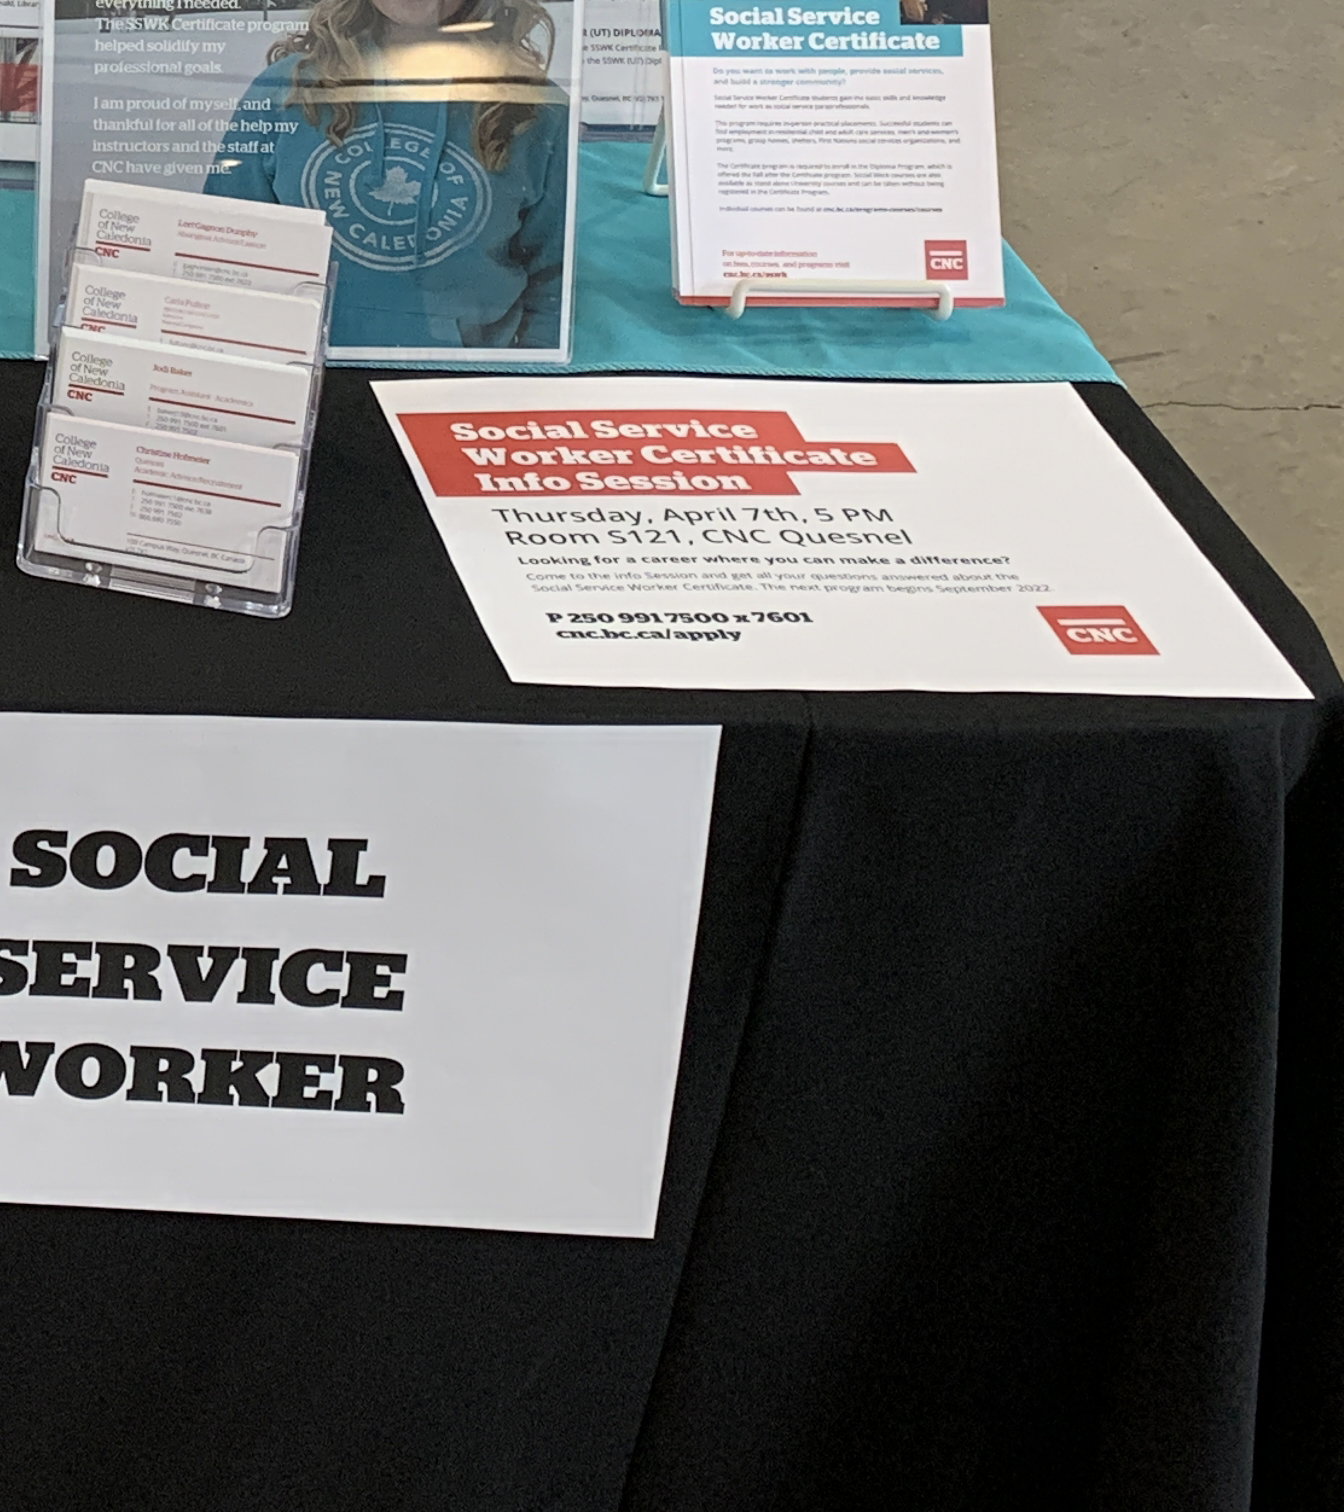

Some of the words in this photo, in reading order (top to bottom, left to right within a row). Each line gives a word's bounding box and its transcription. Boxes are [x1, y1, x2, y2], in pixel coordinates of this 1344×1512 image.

[710, 7, 784, 25] Social
[788, 6, 879, 24] Service
[711, 32, 803, 51] Worker
[808, 31, 939, 51] Certificate
[930, 258, 963, 270] CNC
[450, 421, 589, 441] Social
[592, 420, 758, 439] Service
[462, 446, 633, 466] Worker
[642, 446, 878, 467] Certificate
[476, 472, 572, 492] Info
[580, 471, 752, 491] Session
[492, 507, 654, 526] Thursday,
[662, 507, 735, 525] April
[746, 507, 808, 525] 7th,
[814, 508, 836, 523] 5
[841, 508, 894, 523] PM
[505, 530, 600, 546] Room
[609, 529, 694, 546] S121,
[702, 529, 771, 545] CNC
[780, 528, 912, 547] Quesnel
[546, 613, 563, 623] P
[567, 613, 613, 623] 250
[556, 628, 742, 642] cnc.bc.ca/apply
[1066, 628, 1138, 644] CNC
[10, 827, 386, 899] SOCIAL
